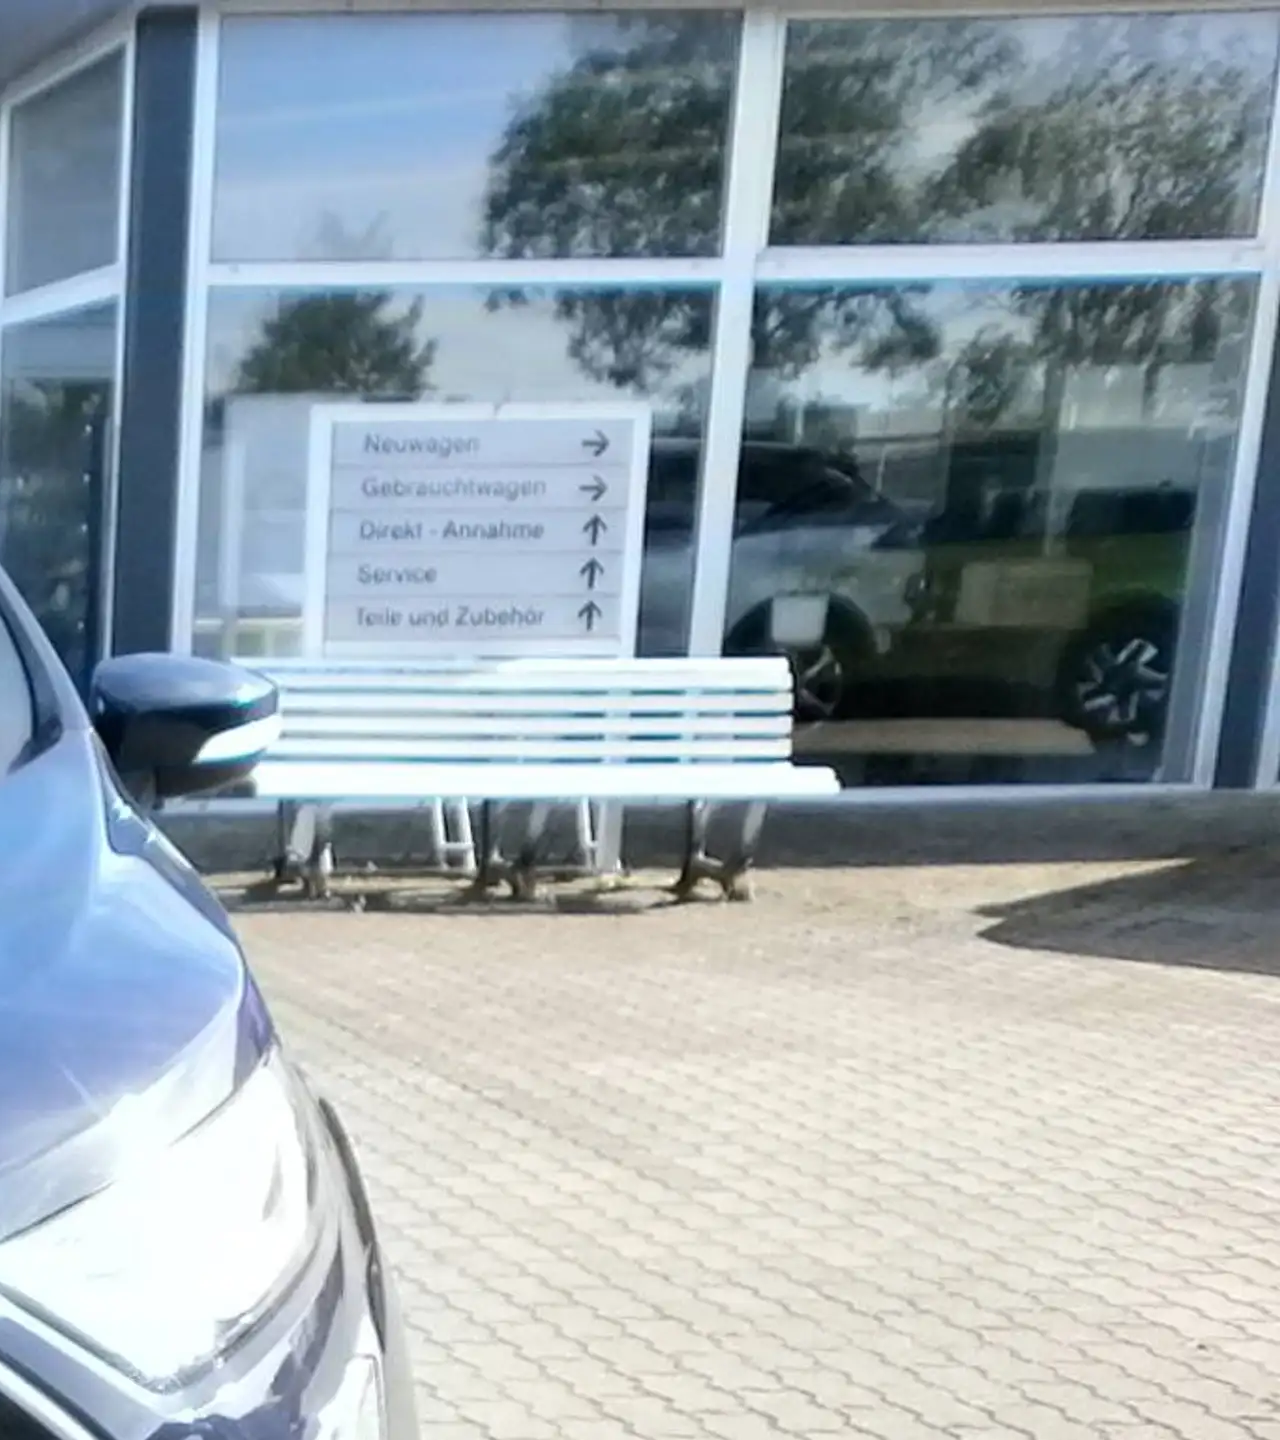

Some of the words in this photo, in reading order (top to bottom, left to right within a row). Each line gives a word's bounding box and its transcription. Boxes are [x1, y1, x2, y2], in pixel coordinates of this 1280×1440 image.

[364, 433, 481, 458] Neuwagen
[361, 476, 547, 502] Gebrauchtwagen
[359, 520, 424, 540] Direkt
[442, 519, 545, 540] Annahme
[357, 564, 438, 584] Service
[356, 607, 404, 627] Teile
[408, 607, 450, 627] und
[455, 604, 545, 627] Zubehör
